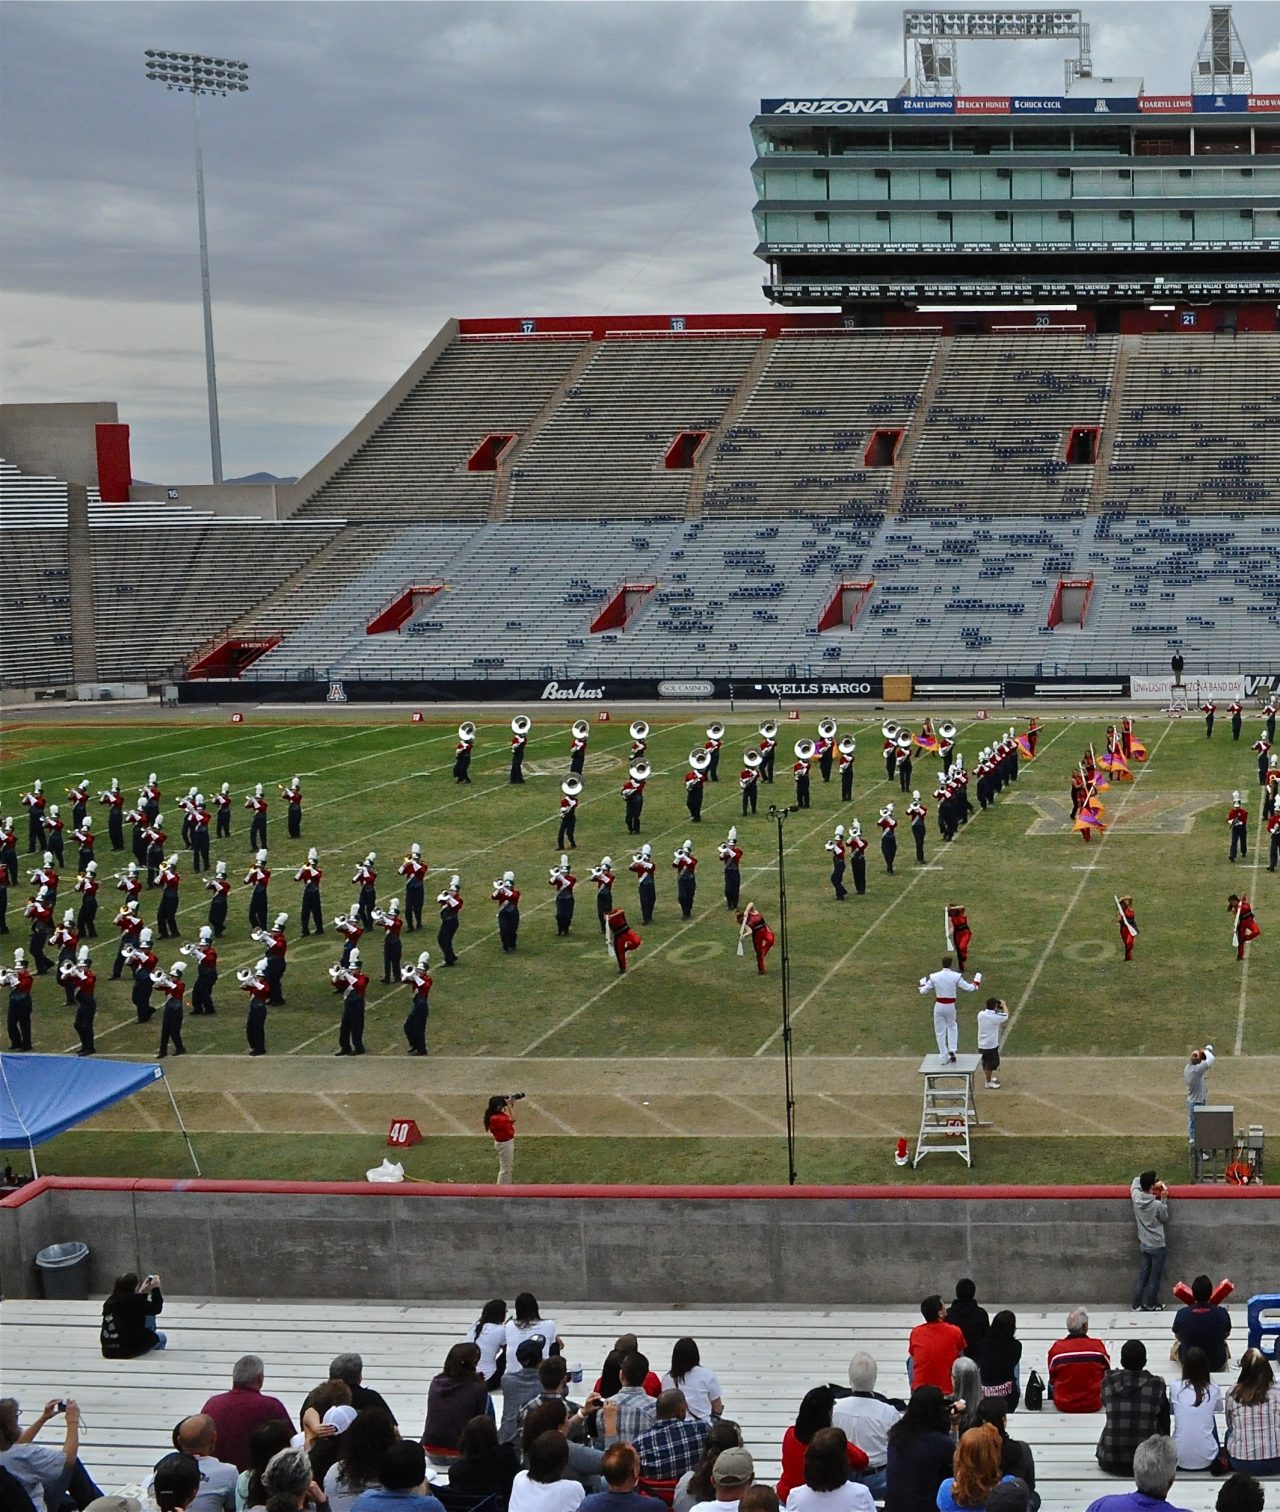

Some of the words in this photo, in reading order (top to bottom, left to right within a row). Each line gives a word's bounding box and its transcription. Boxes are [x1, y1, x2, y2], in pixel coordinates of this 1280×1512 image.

[774, 100, 888, 114] ARIZONA
[903, 101, 911, 109] 22
[844, 320, 854, 328] 19
[1036, 317, 1049, 326] 20
[1183, 316, 1194, 325] 21
[522, 325, 532, 333] 17
[672, 322, 683, 331] 18
[168, 489, 178, 499] 16
[541, 681, 605, 699] Bashas'
[767, 683, 819, 694] WELLS
[821, 683, 871, 694] FARGO
[1133, 682, 1168, 692] UNIVERSITY
[1209, 682, 1227, 692] BAND
[1228, 682, 1242, 692] DAY
[390, 1122, 409, 1143] 40
